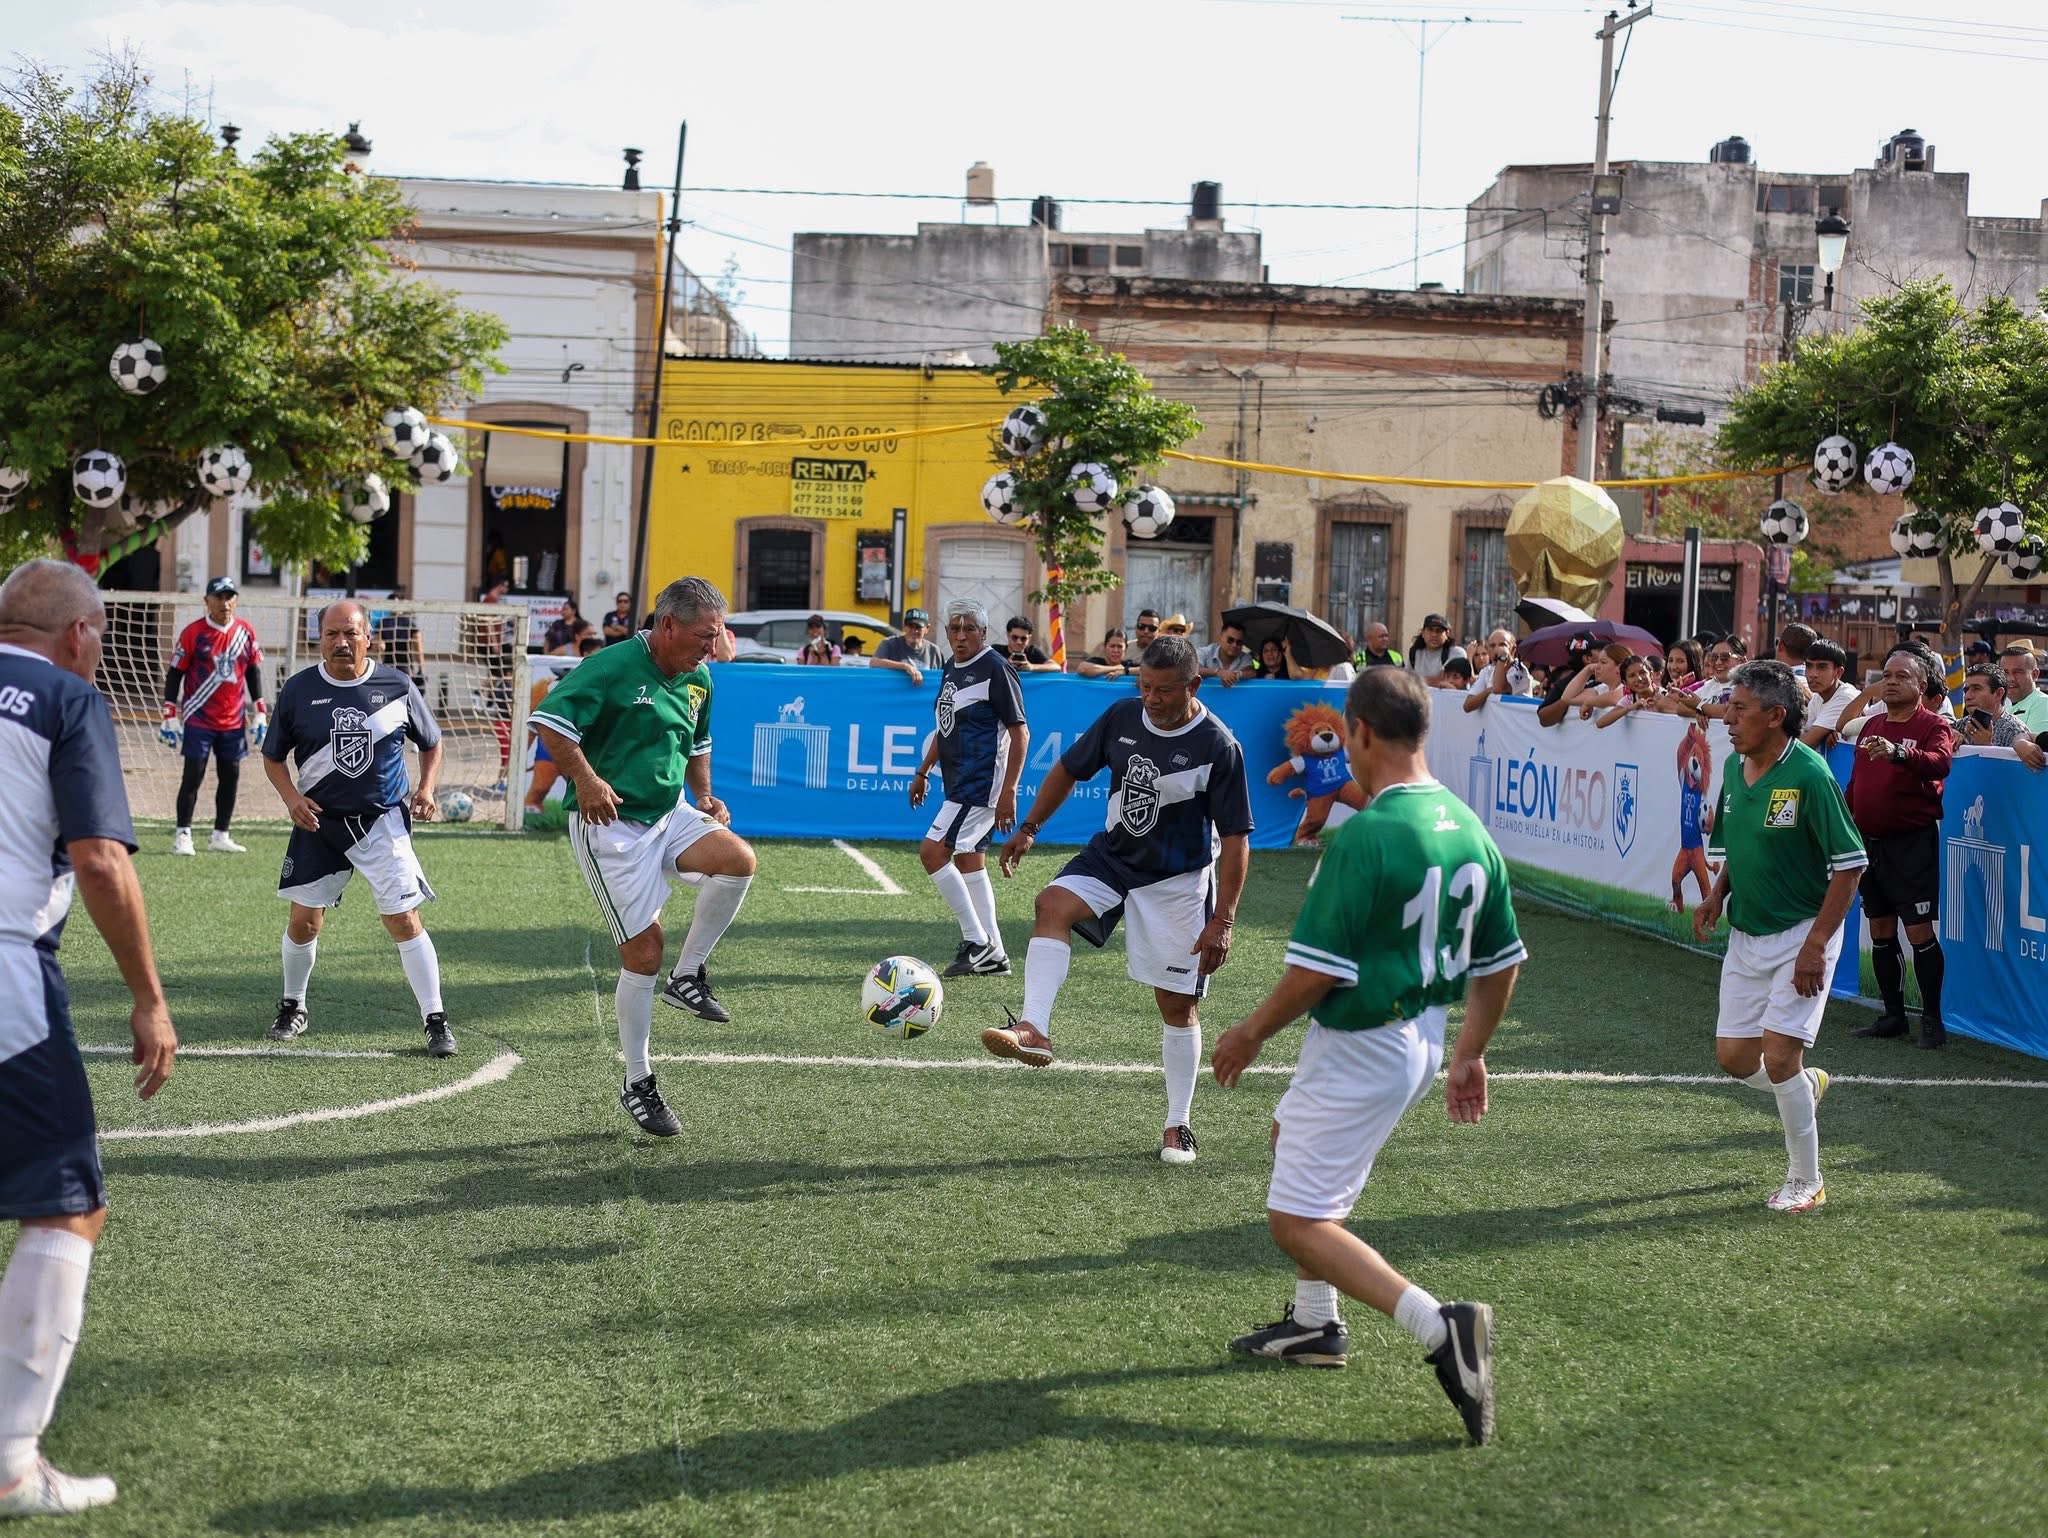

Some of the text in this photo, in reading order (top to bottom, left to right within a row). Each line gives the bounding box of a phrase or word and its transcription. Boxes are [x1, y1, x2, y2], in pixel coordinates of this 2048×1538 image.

[759, 461, 793, 476] JOCH
[795, 461, 864, 481] RENTA
[794, 481, 864, 493] 477 223 15 17
[794, 494, 811, 504] 477
[815, 495, 832, 504] 223
[837, 495, 848, 504] 15
[793, 506, 811, 515] 477
[815, 506, 832, 516] 715
[1626, 570, 1642, 588] El
[1646, 565, 1681, 588] Rayo
[1074, 787, 1111, 799] HIST
[1495, 816, 1605, 852] DEJANDO HUELLA EN LA HISTORIA
[1401, 862, 1488, 988] 13
